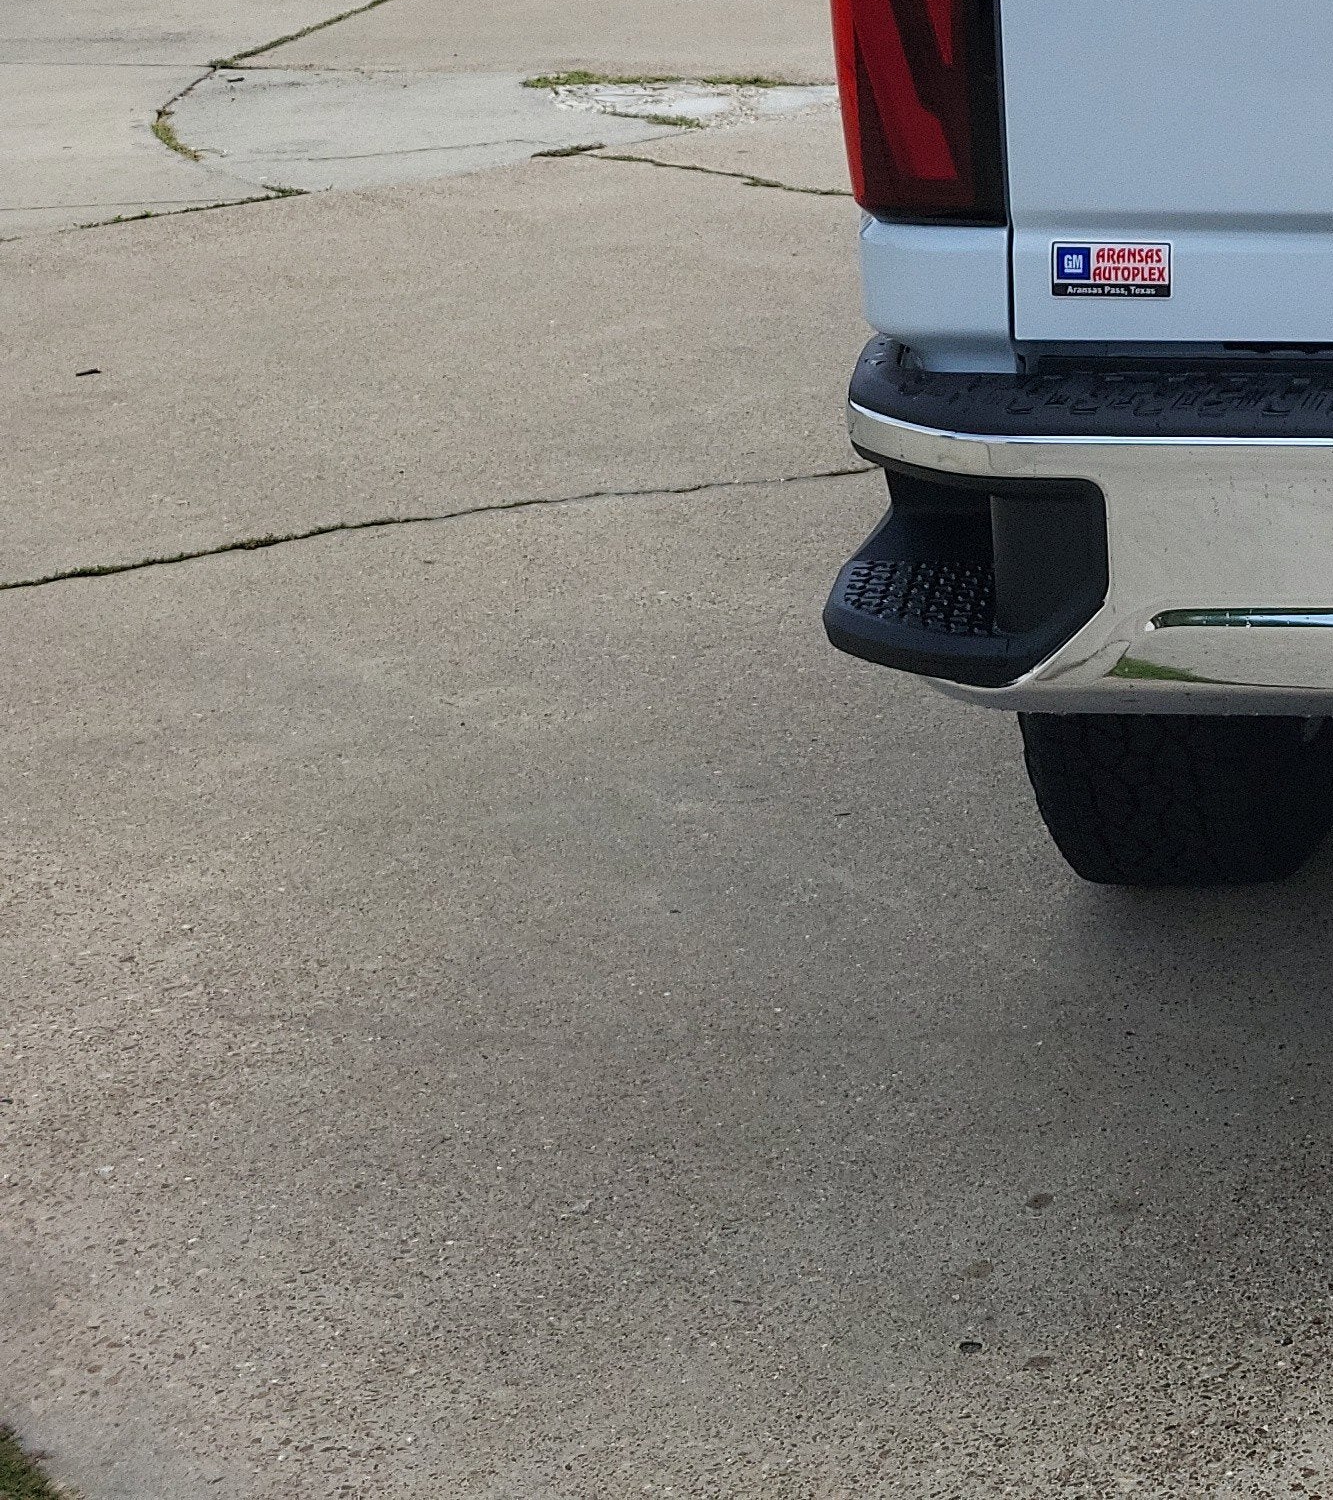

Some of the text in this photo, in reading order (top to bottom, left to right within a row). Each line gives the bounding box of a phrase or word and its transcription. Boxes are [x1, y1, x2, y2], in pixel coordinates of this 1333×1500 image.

[1064, 254, 1083, 270] GM
[1096, 247, 1162, 265] ARANSAS
[1092, 266, 1167, 282] AUTOPLEX
[1066, 286, 1102, 294] Aransas
[1130, 286, 1156, 296] Texas
